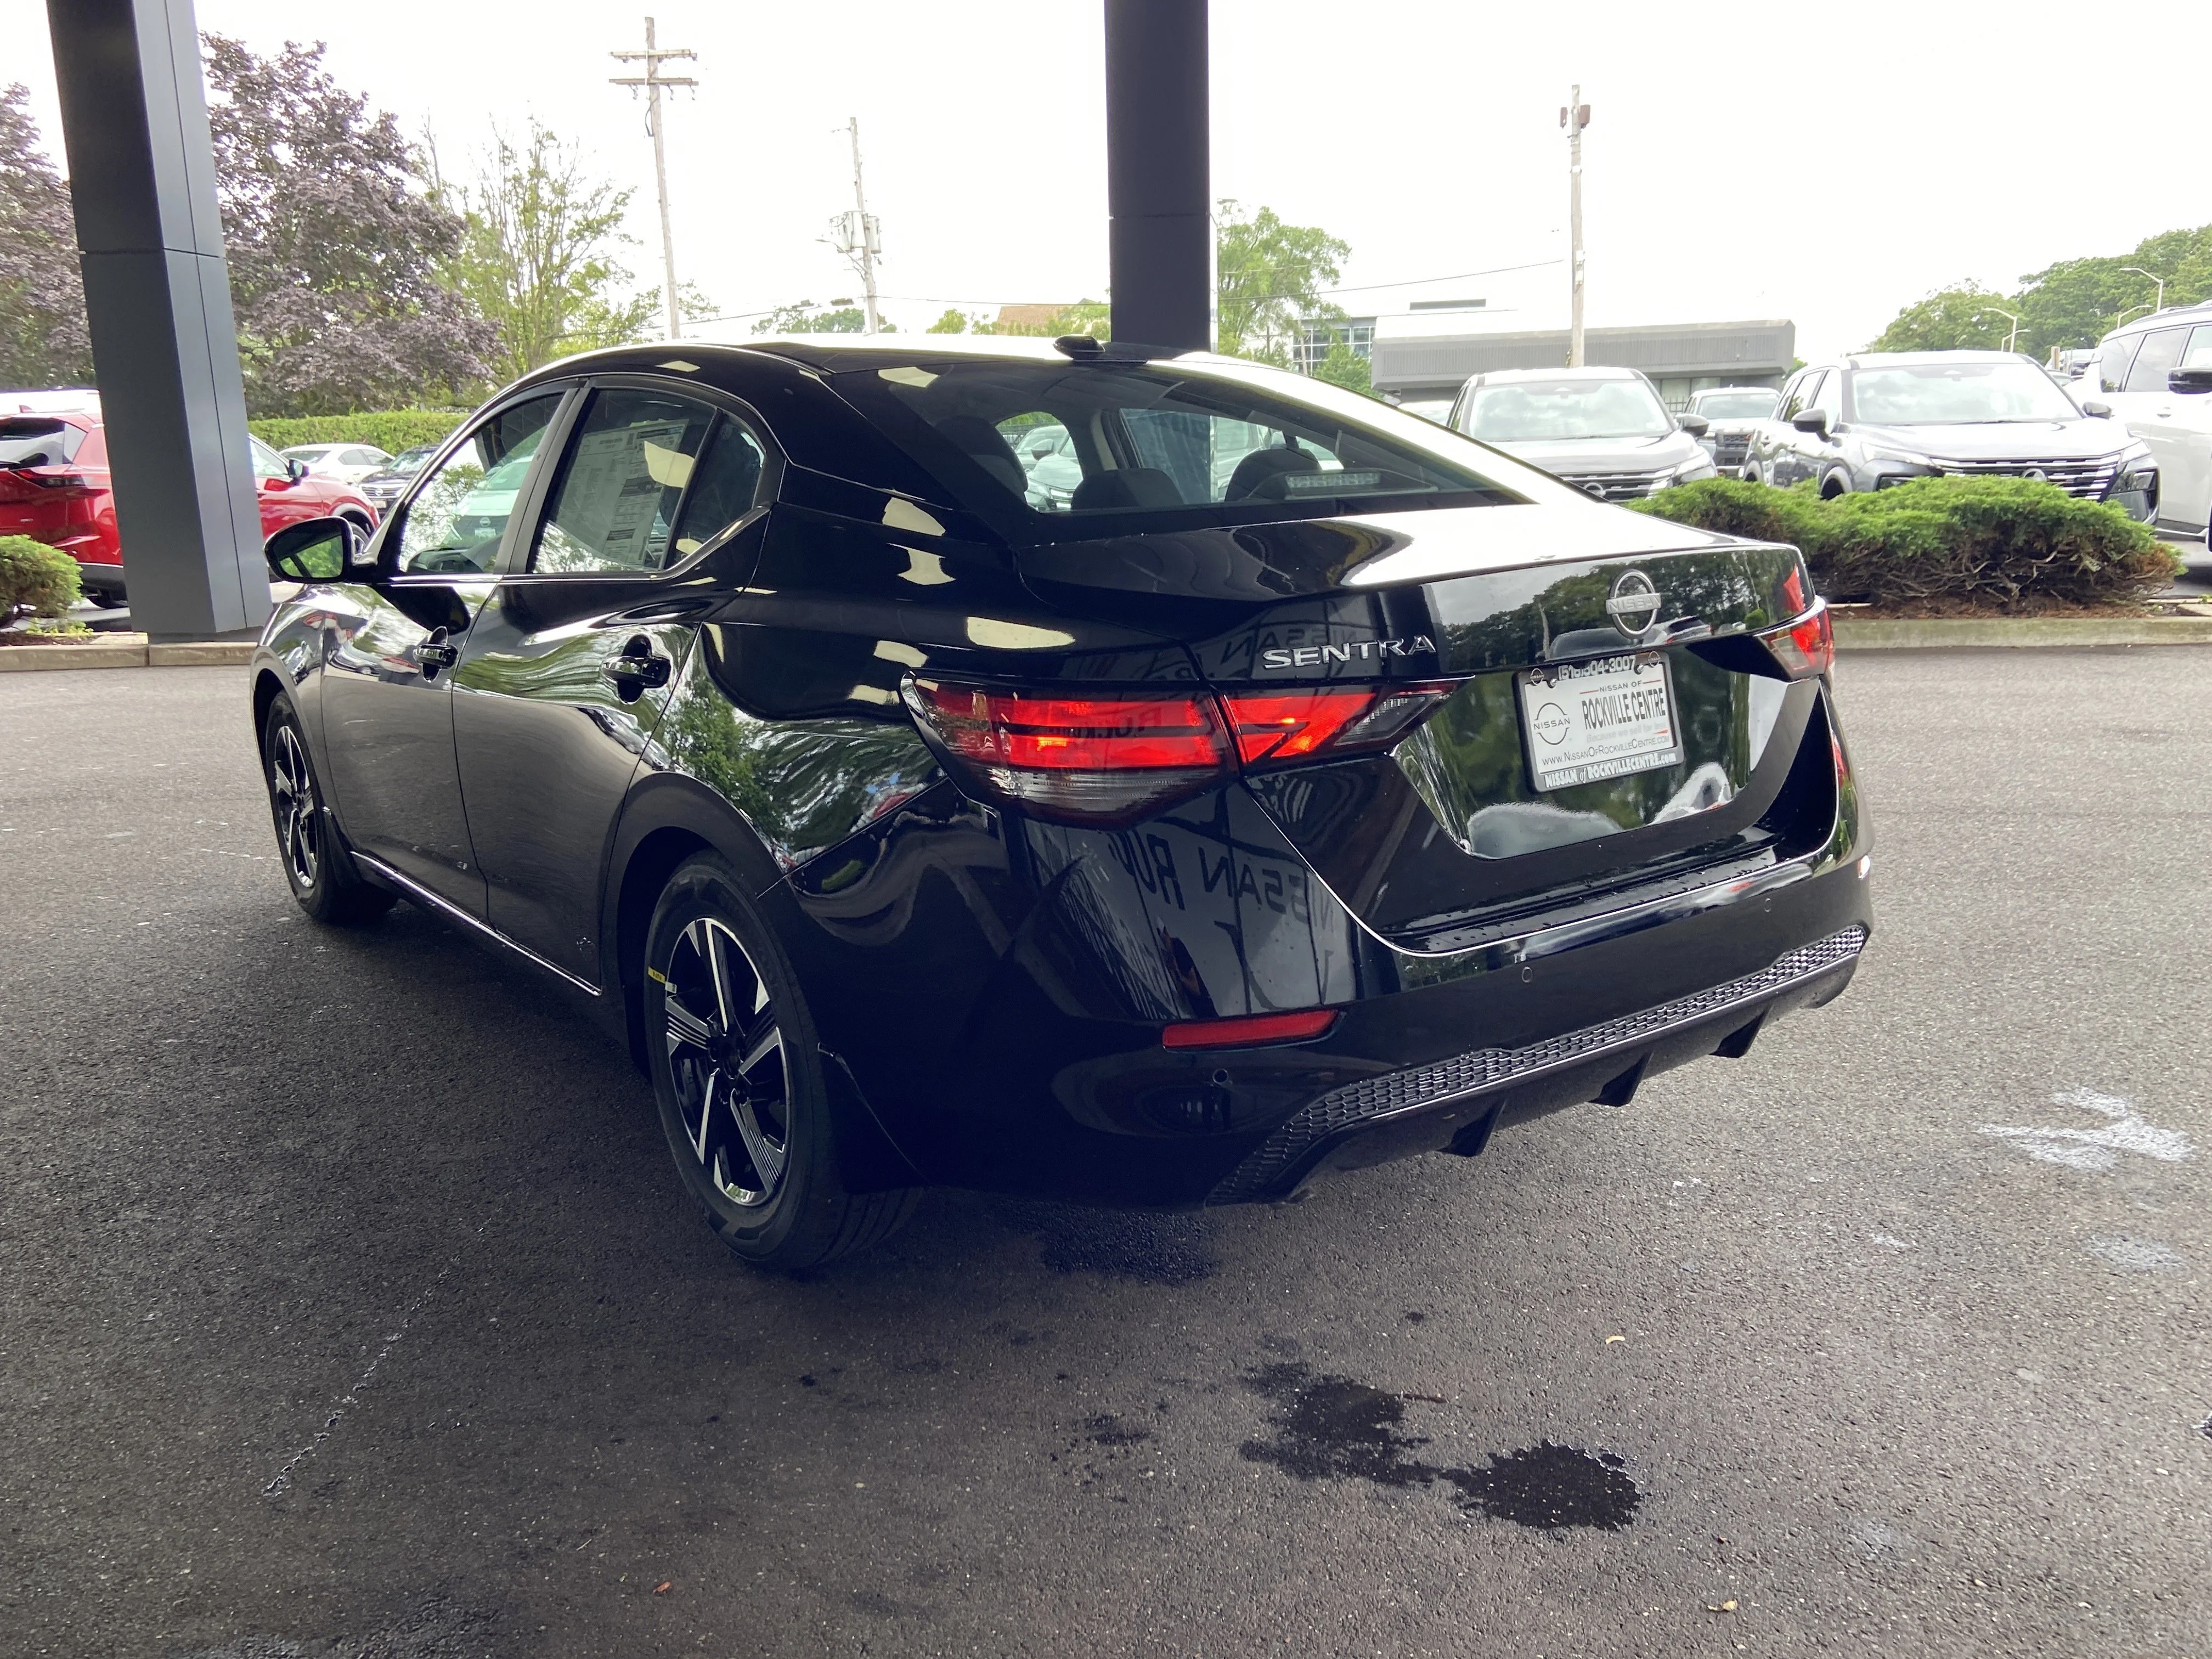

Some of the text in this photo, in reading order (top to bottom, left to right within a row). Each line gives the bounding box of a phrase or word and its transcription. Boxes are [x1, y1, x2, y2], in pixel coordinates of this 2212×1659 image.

[1608, 596, 1660, 612] NISSAN
[1263, 635, 1437, 669] SENTRA
[1599, 682, 1628, 692] NISSAN
[1582, 687, 1666, 730] ROCKVILLE CENTRE
[1533, 717, 1571, 730] NISSAN
[1586, 731, 1617, 743] Because
[1629, 724, 1642, 735] sell
[1544, 752, 1677, 788] NISSAN of ROCKVILLECENTRE.com
